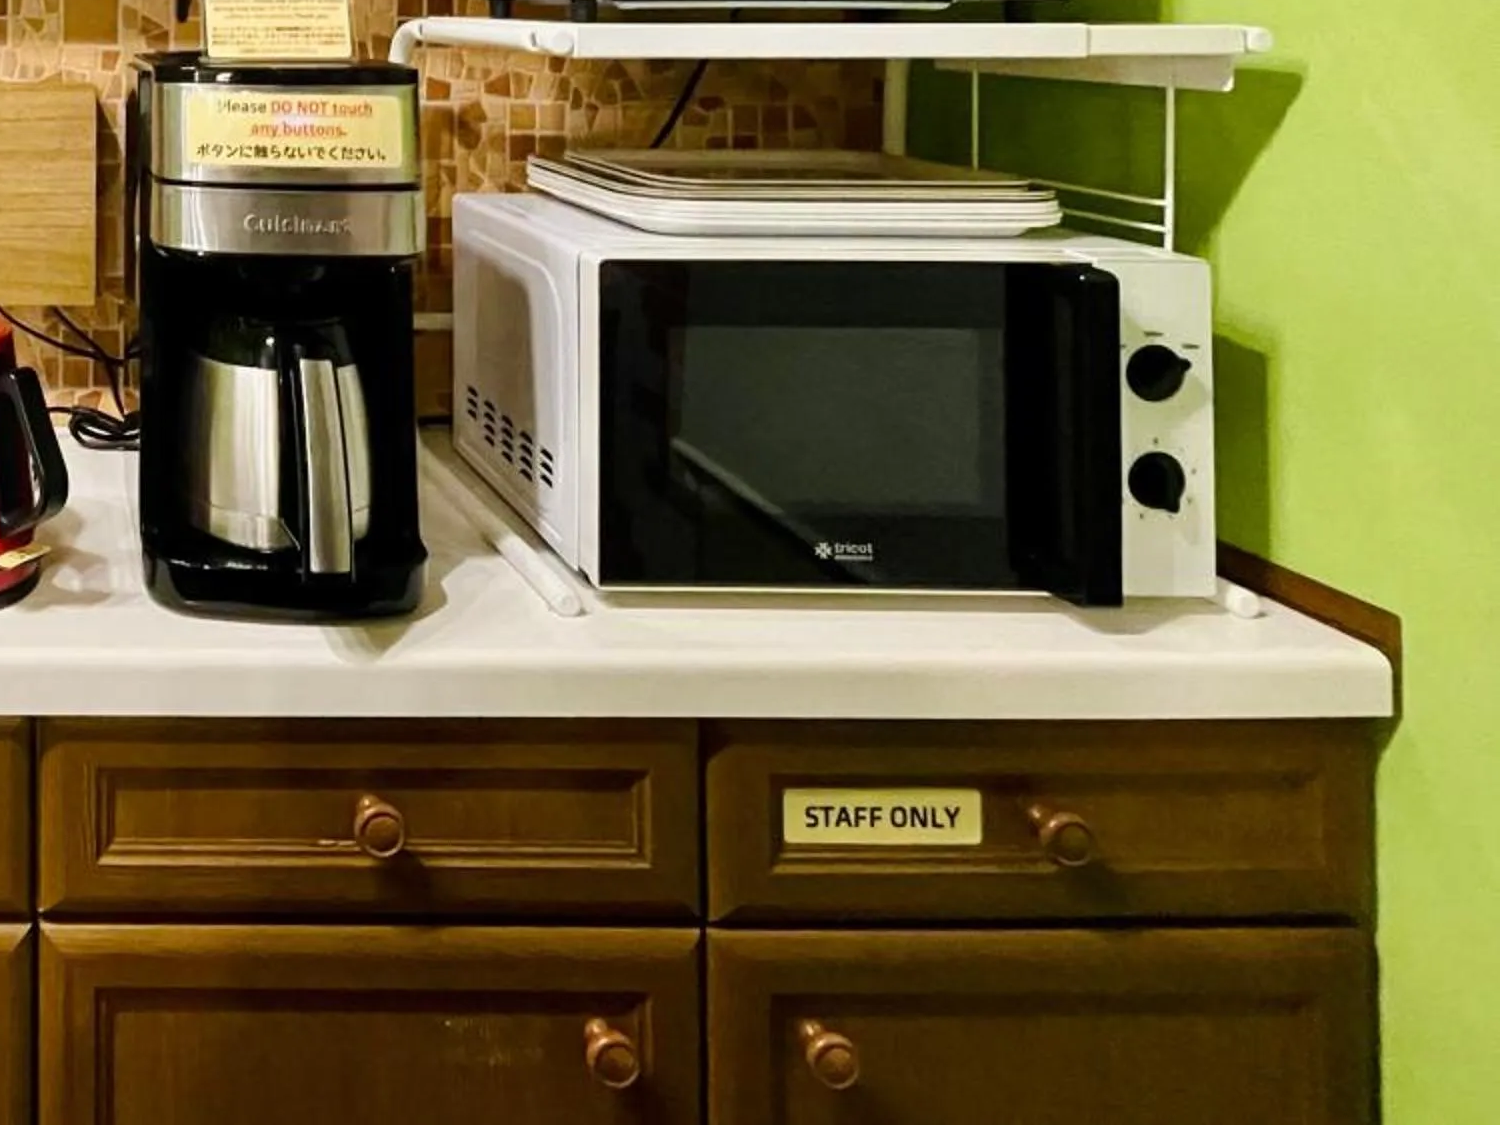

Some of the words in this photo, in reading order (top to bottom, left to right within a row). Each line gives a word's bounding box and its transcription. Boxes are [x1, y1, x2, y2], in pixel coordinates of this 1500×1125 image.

[218, 98, 267, 114] Please
[270, 100, 293, 114] DO
[297, 101, 329, 114] NOT
[332, 101, 373, 116] touch
[251, 123, 279, 139] any
[282, 121, 348, 137] buttons.
[804, 805, 884, 829] STAFF
[889, 805, 962, 829] ONLY
